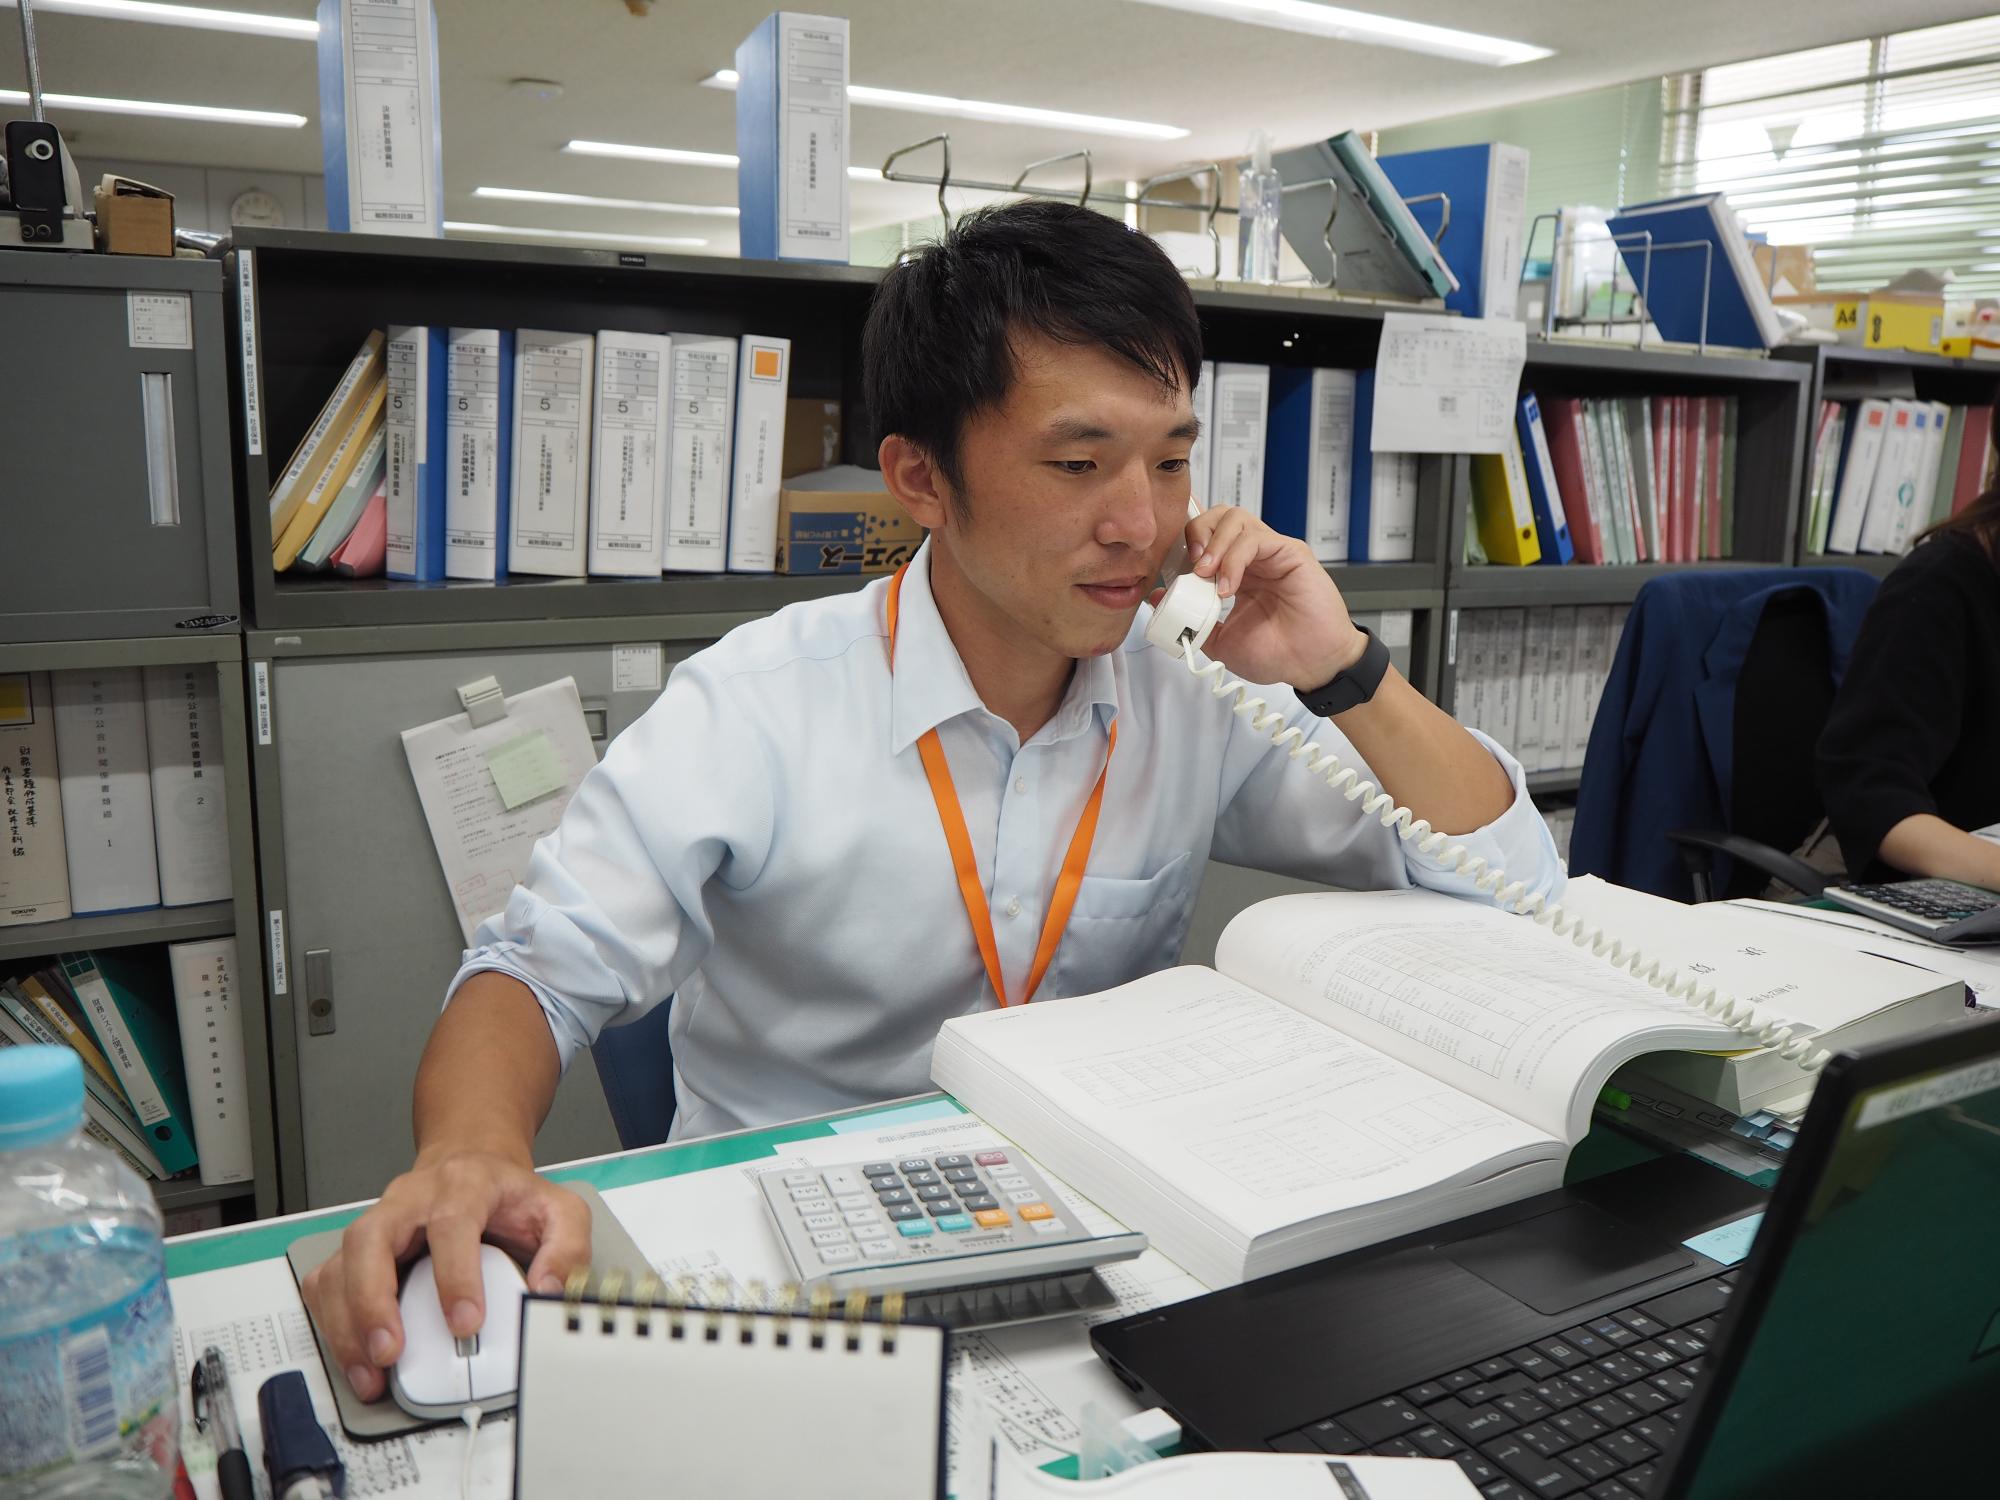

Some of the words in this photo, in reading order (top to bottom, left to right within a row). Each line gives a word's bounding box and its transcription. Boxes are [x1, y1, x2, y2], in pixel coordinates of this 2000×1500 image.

[1837, 309, 1857, 323] A4
[394, 397, 403, 408] 5
[459, 398, 468, 410] 5
[540, 399, 551, 410] 5
[618, 401, 628, 413] 5
[689, 402, 698, 414] 5
[196, 796, 205, 805] 2
[107, 839, 113, 848] 1
[881, 1178, 893, 1186] 3
[918, 1173, 929, 1181] 2
[890, 1191, 902, 1199] 6
[928, 1187, 939, 1195] 5
[978, 1195, 989, 1204] 7
[900, 1205, 911, 1213] 9
[1686, 1340, 1705, 1351] N
[1653, 1350, 1674, 1363] M
